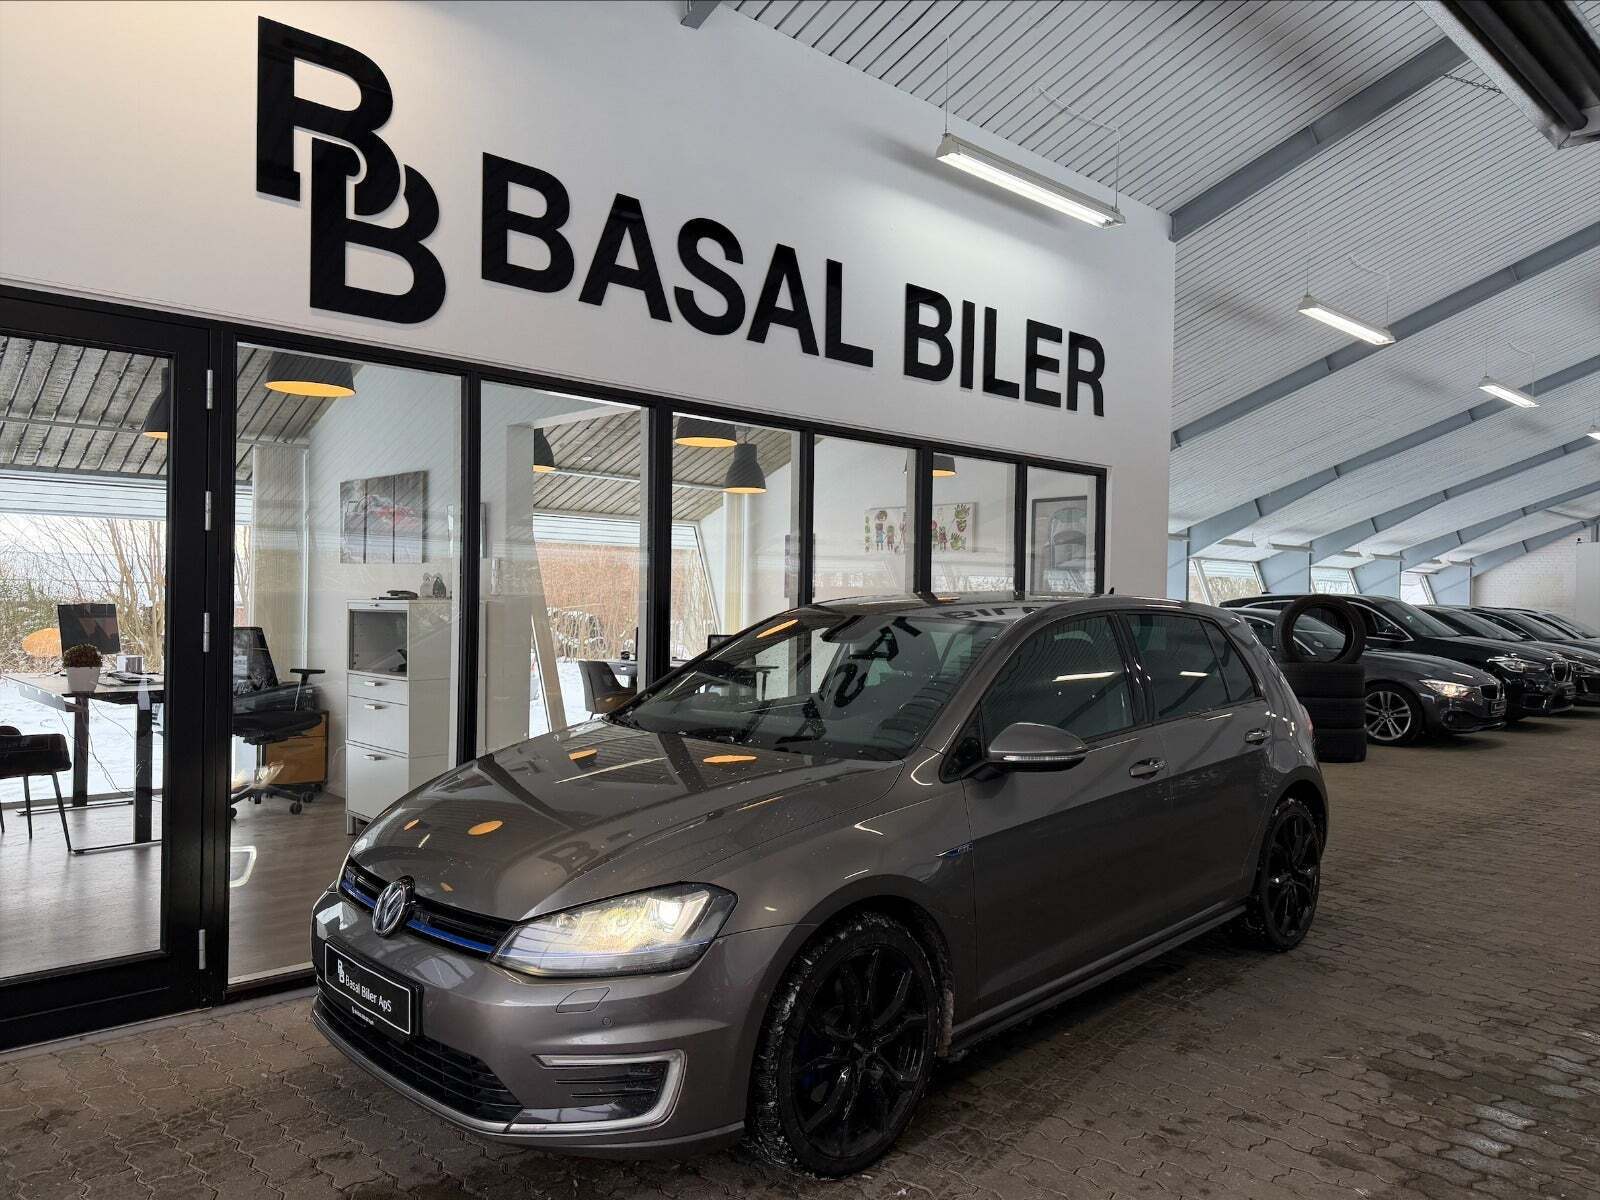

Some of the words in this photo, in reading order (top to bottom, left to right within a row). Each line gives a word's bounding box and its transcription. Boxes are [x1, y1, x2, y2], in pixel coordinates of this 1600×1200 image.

[481, 151, 874, 368] BASAL
[903, 282, 1105, 417] BILER
[345, 974, 361, 995] Basal
[361, 985, 378, 1004] Biler
[378, 995, 392, 1012] ApS
